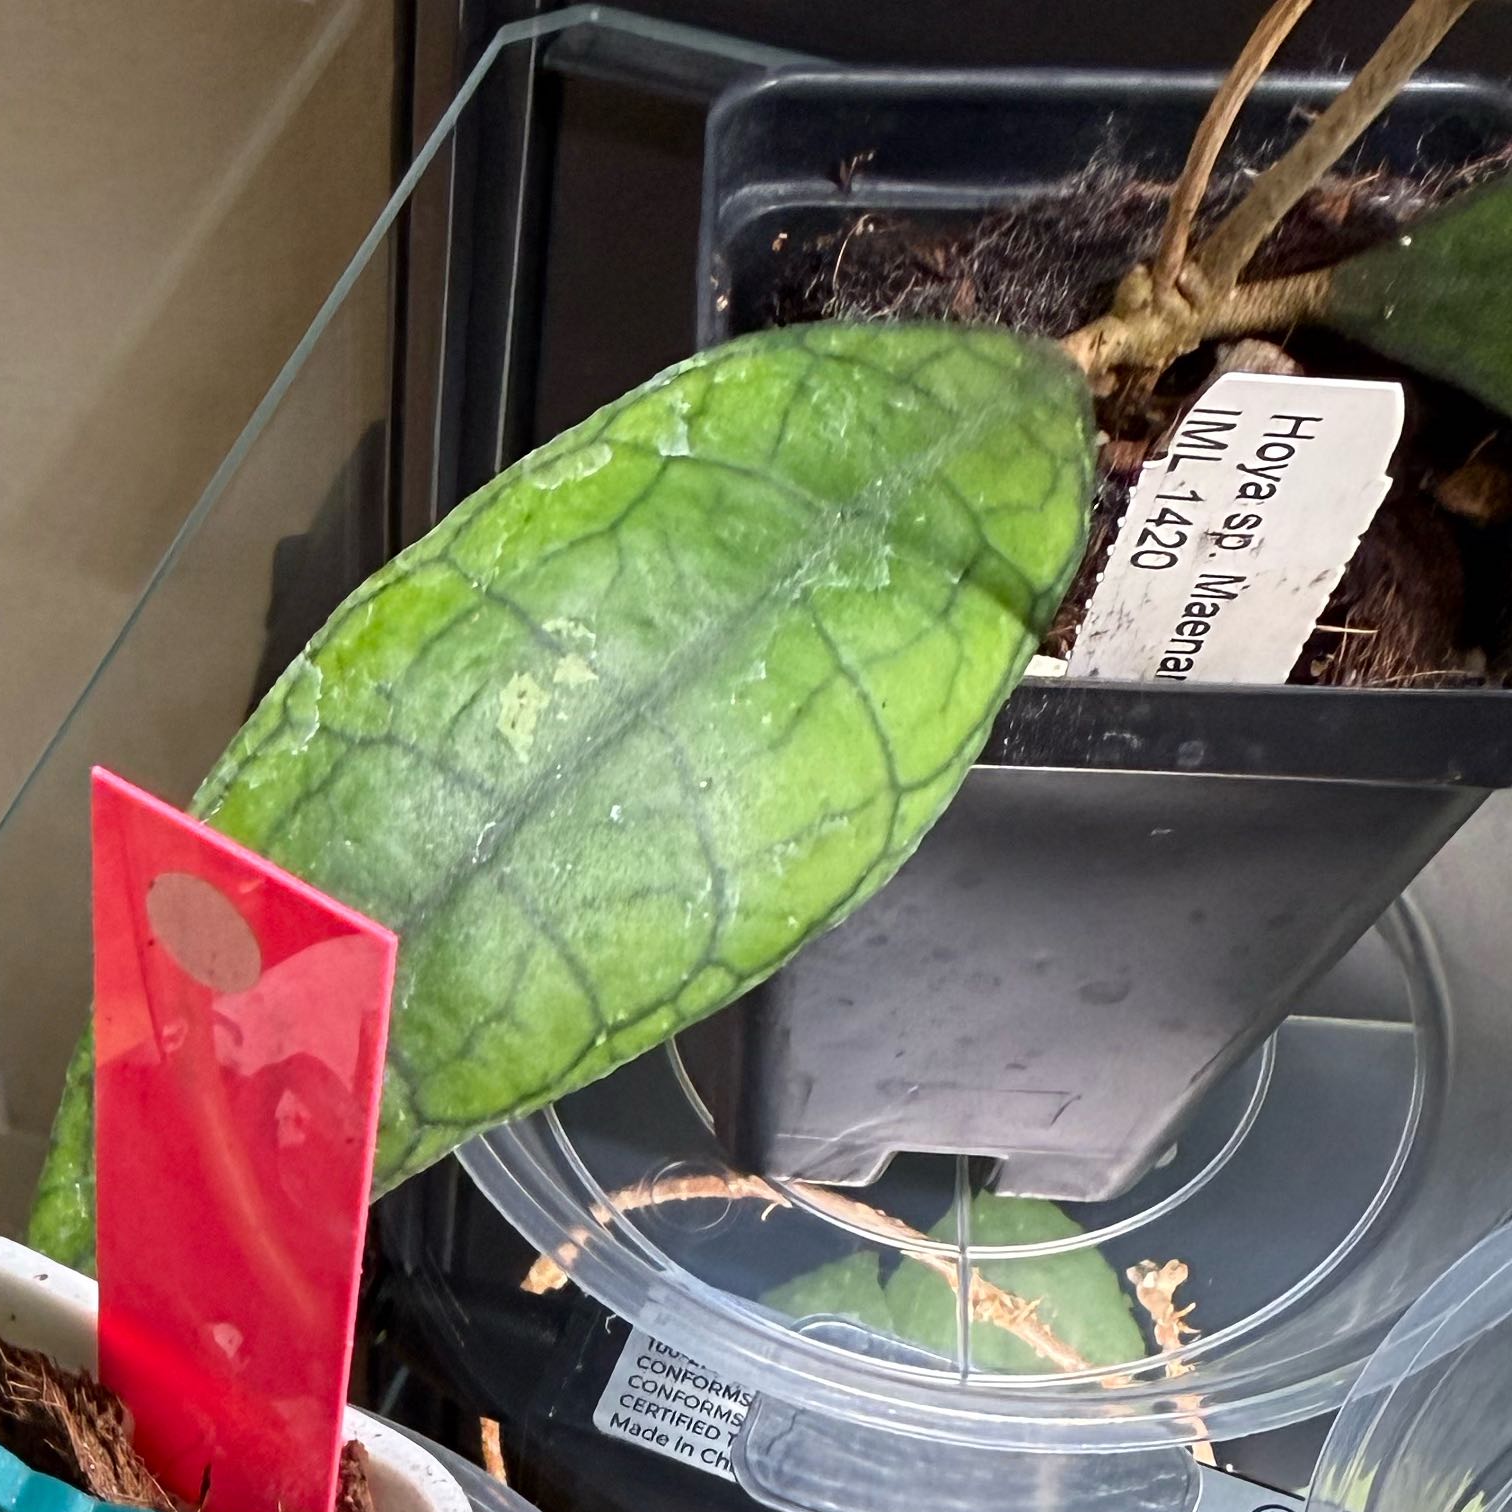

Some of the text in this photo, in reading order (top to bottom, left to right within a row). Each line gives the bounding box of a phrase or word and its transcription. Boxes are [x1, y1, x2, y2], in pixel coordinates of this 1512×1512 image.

[1235, 413, 1324, 500] Hoya
[1129, 407, 1244, 571] IML 1420
[1205, 512, 1264, 558] sp.
[628, 1374, 746, 1428] CONFORMS
[636, 1354, 754, 1407] CONFORMS
[609, 1412, 670, 1447] Made
[674, 1435, 695, 1457] In
[619, 1393, 721, 1440] CERTIFIED
